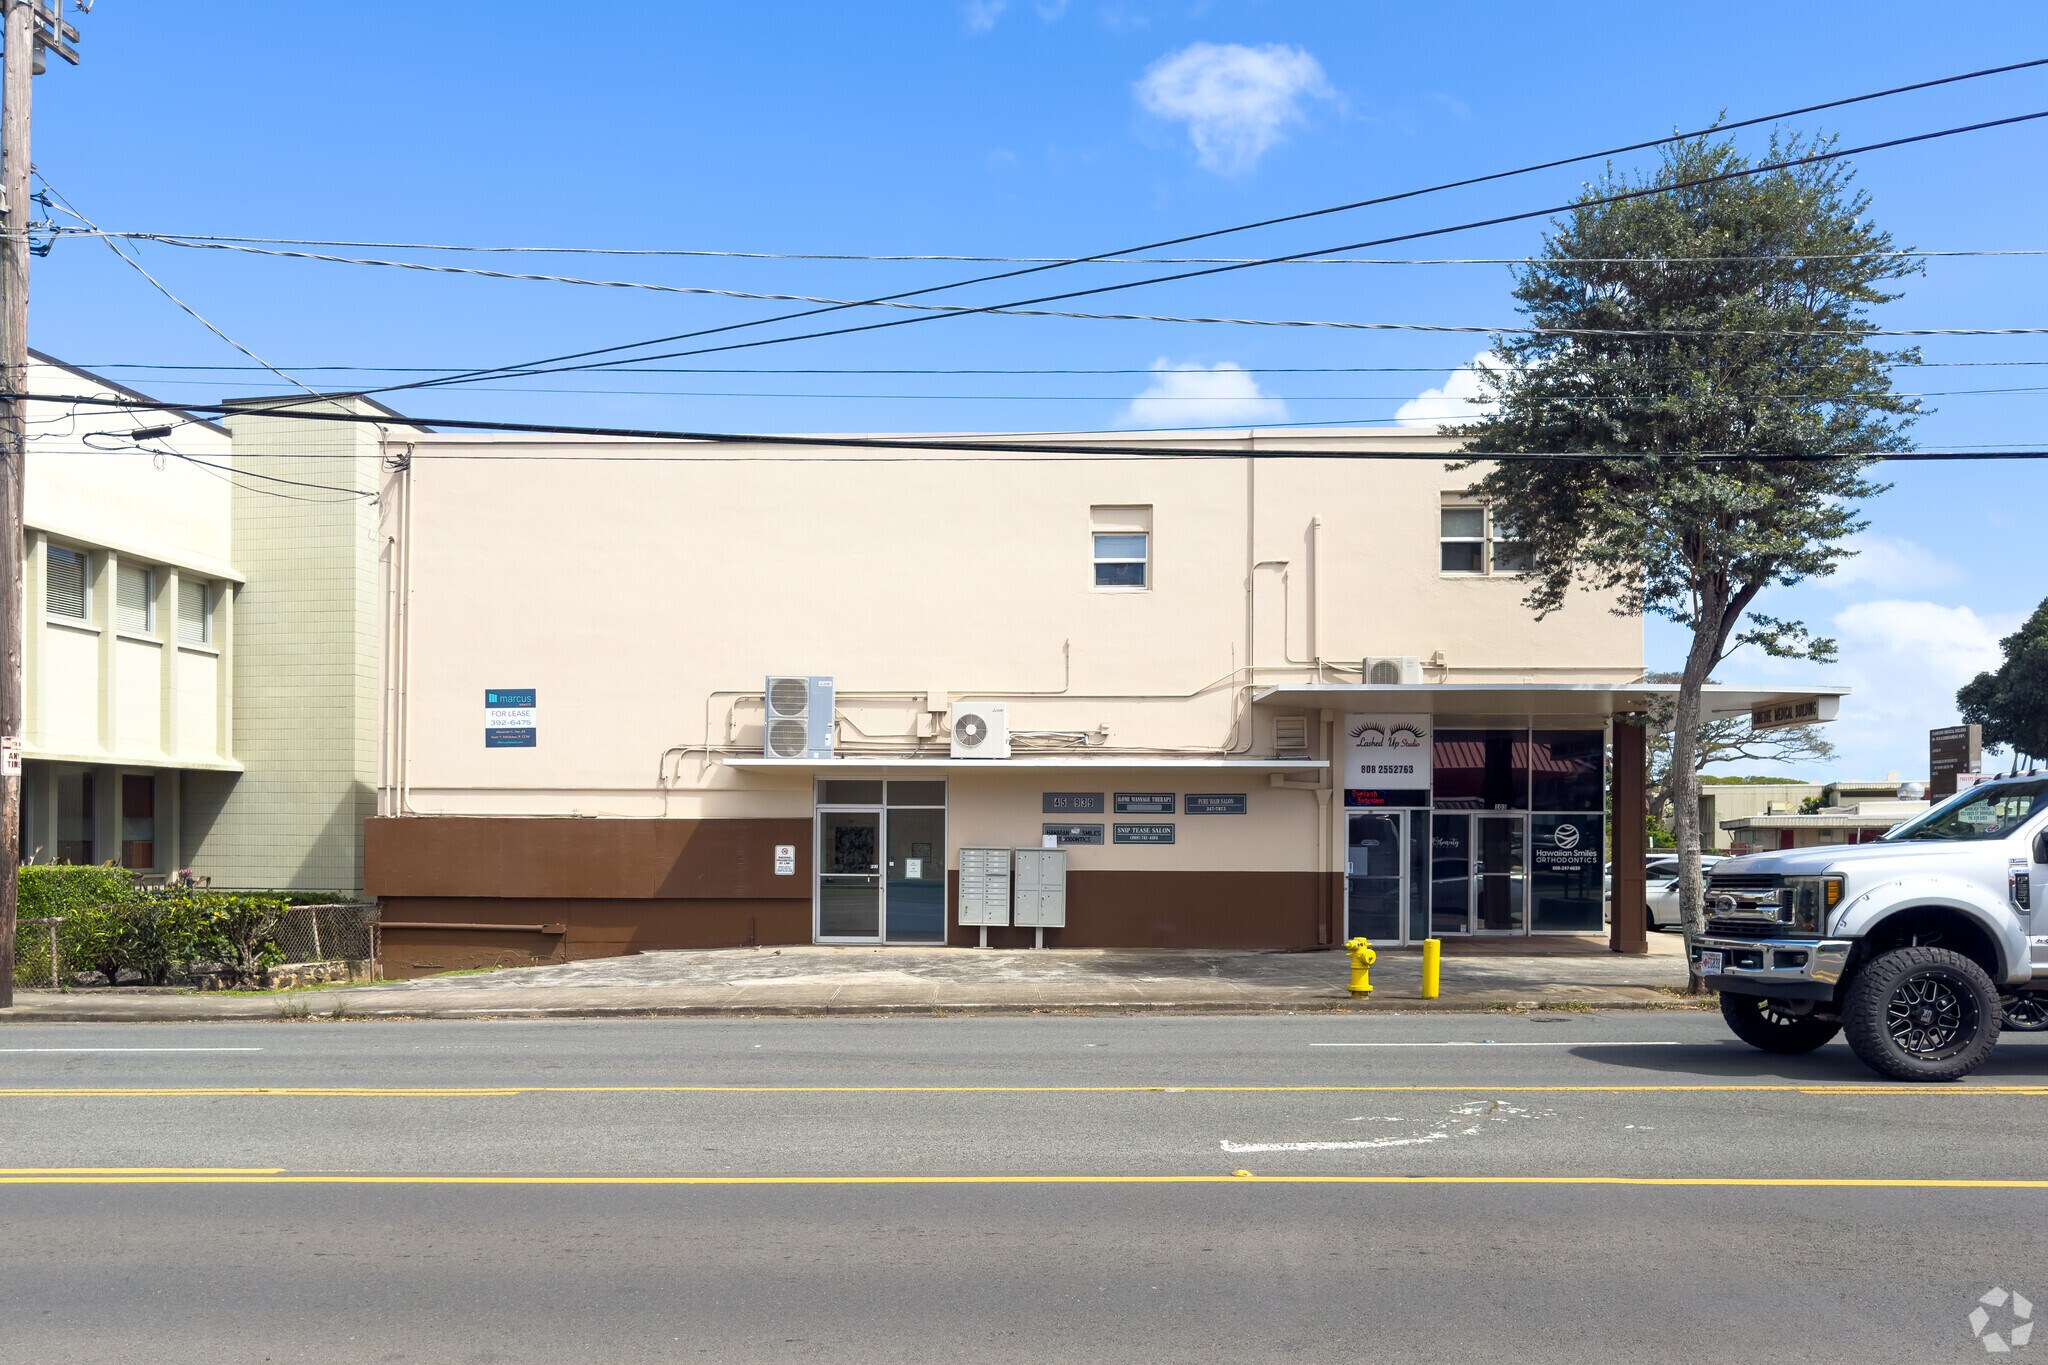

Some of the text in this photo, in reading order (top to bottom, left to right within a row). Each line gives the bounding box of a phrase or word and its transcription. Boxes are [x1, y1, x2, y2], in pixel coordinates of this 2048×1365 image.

[500, 695, 532, 703] marcus
[1356, 736, 1420, 749] Lashed Up Studio
[1361, 765, 1414, 774] 808 2552763
[1054, 797, 1094, 808] 45 939
[1536, 849, 1598, 857] Hawaiian Smiles
